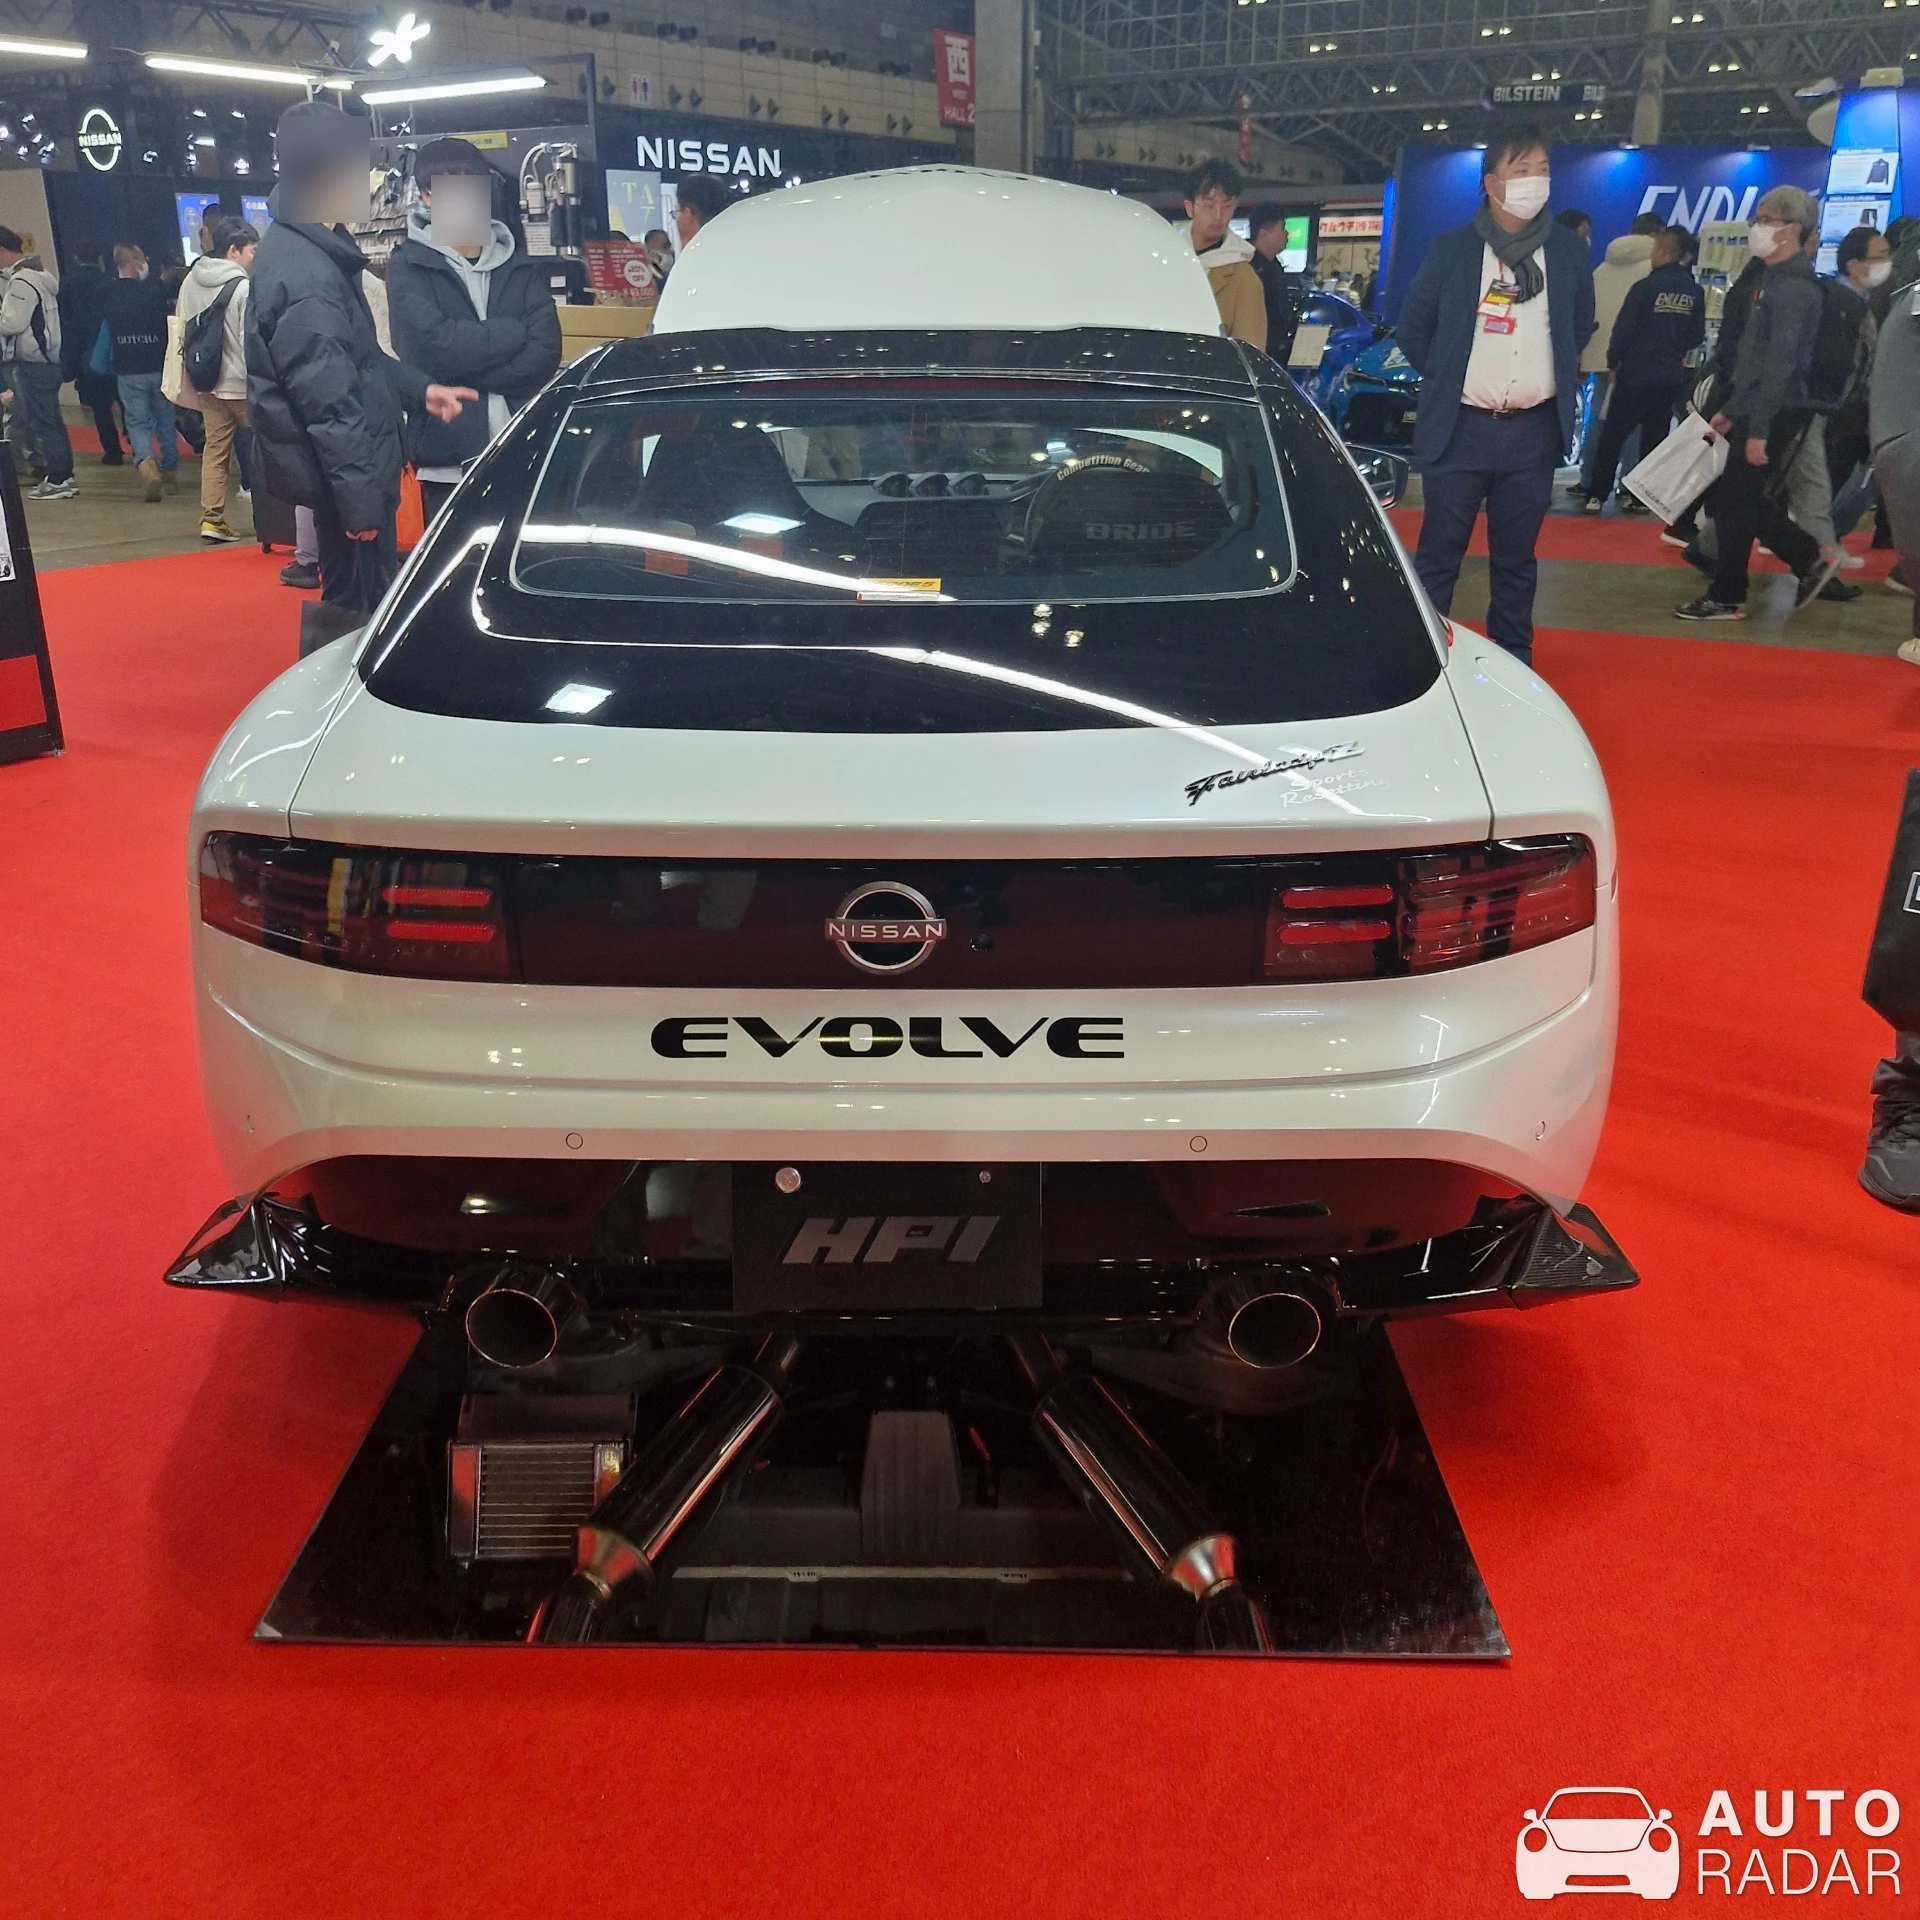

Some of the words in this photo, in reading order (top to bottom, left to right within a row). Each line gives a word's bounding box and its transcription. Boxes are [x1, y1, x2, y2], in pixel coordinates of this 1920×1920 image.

[944, 35, 970, 86] 西
[1493, 85, 1561, 102] BILSTEIN
[944, 104, 966, 121] HALL
[78, 133, 122, 147] NISSAN
[636, 135, 782, 178] NISSAN
[1056, 455, 1121, 481] Competition
[1123, 458, 1150, 473] Gear
[1086, 522, 1196, 541] BRIDE
[1280, 776, 1391, 808] Resetting
[1290, 768, 1369, 793] Sports
[828, 922, 943, 939] NISSAN
[651, 1017, 1125, 1058] EVOLVE
[782, 1215, 1000, 1264] HPI
